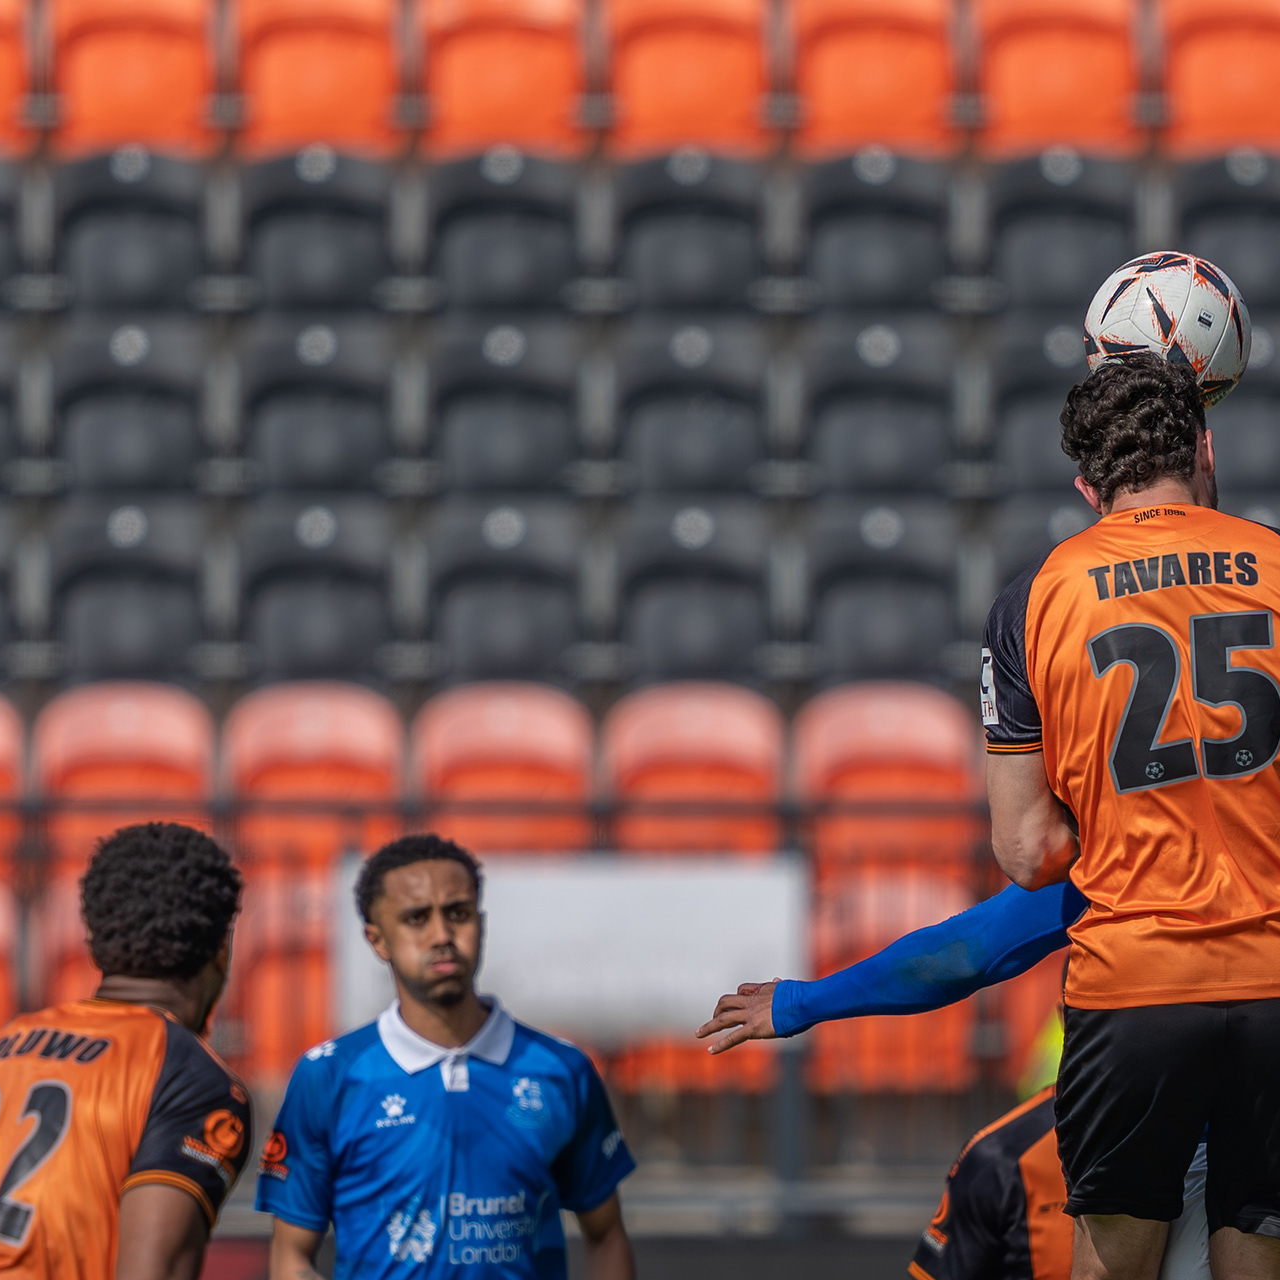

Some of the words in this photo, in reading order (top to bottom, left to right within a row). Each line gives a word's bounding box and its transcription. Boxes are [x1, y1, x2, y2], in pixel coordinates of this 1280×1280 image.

[1134, 508, 1161, 524] SINCE
[1088, 552, 1259, 601] TAVARES
[449, 1187, 525, 1216] Brunel
[449, 1218, 535, 1240] Univers
